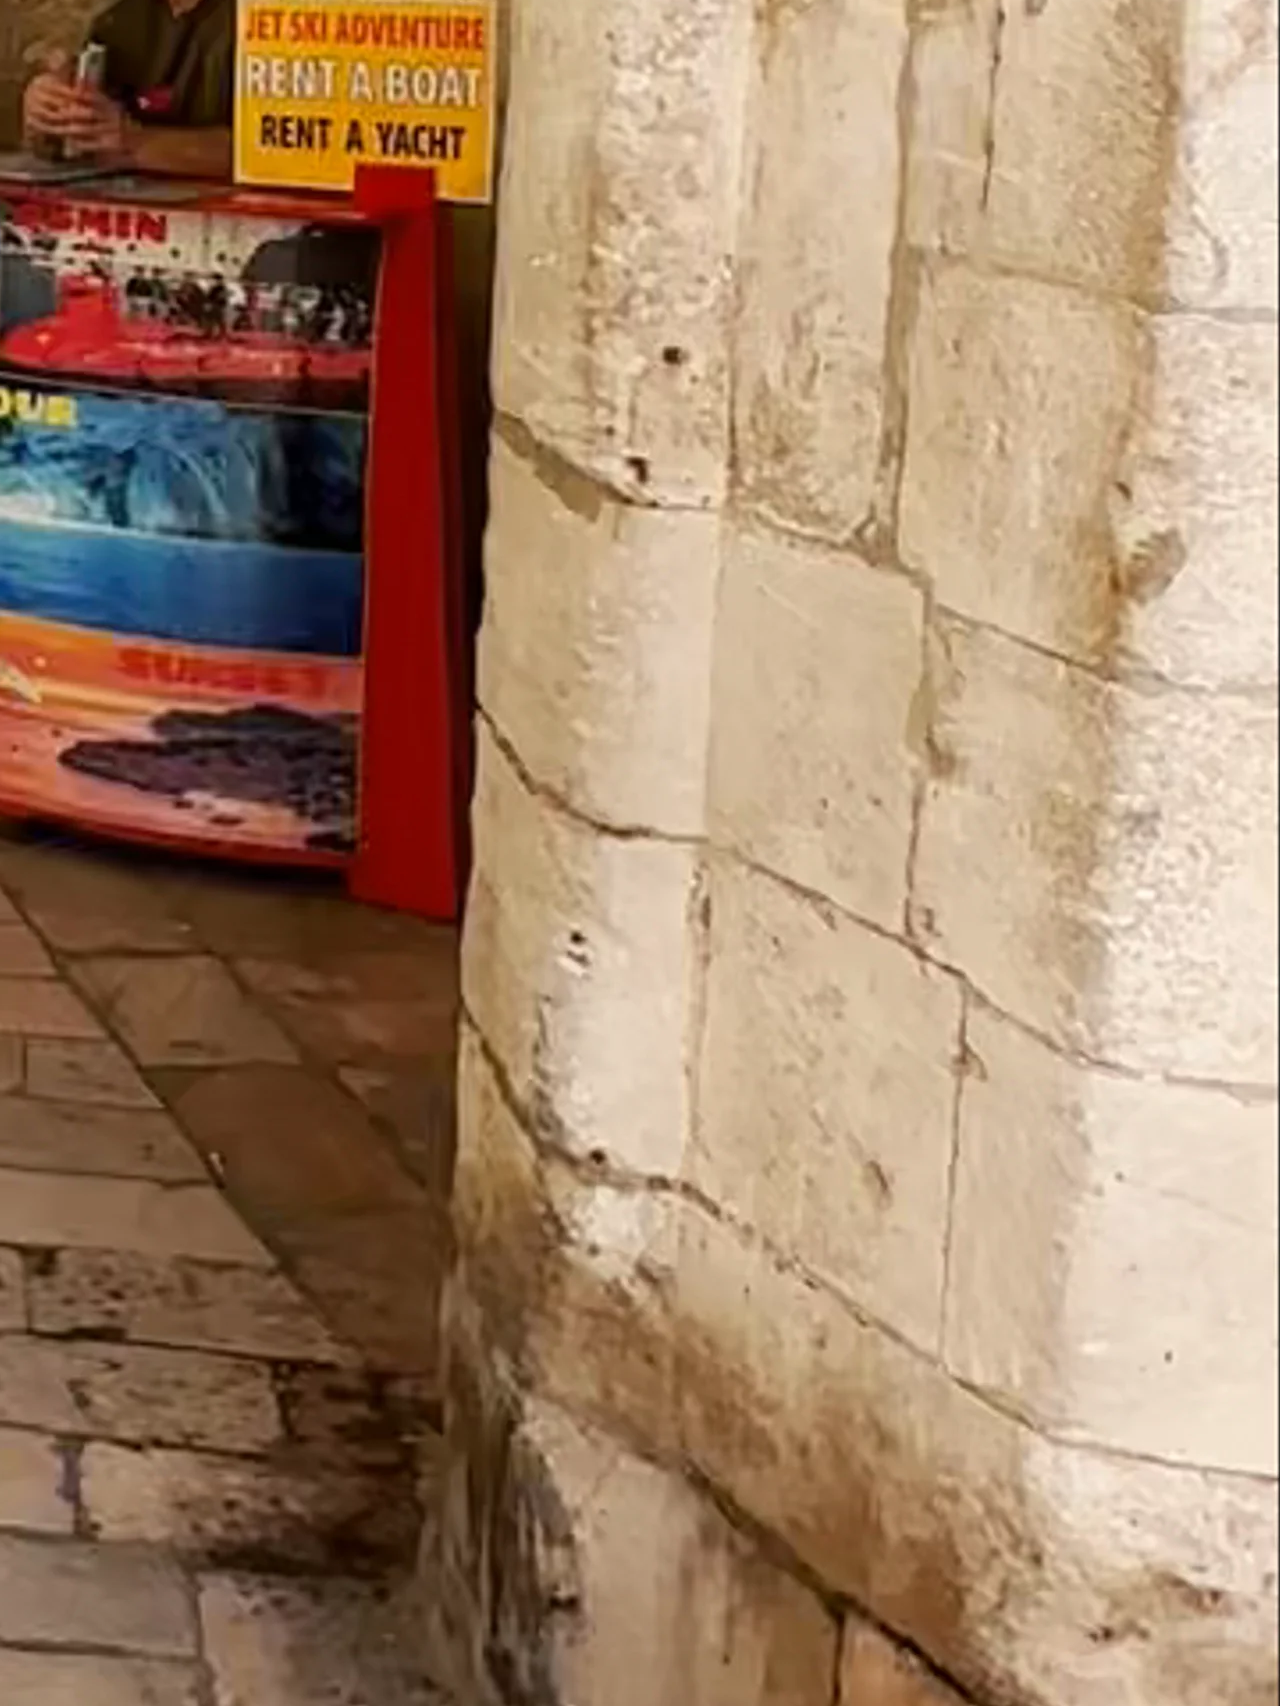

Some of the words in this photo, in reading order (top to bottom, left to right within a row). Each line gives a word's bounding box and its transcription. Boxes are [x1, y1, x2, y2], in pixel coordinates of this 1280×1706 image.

[246, 10, 286, 41] JET
[290, 11, 329, 43] SKI
[335, 12, 484, 50] ADVENTURE
[246, 55, 337, 99] RENT
[350, 61, 373, 103] A
[385, 64, 482, 108] BOAT
[260, 115, 333, 150] RENT
[346, 118, 364, 154] A
[375, 121, 466, 160] YACHT
